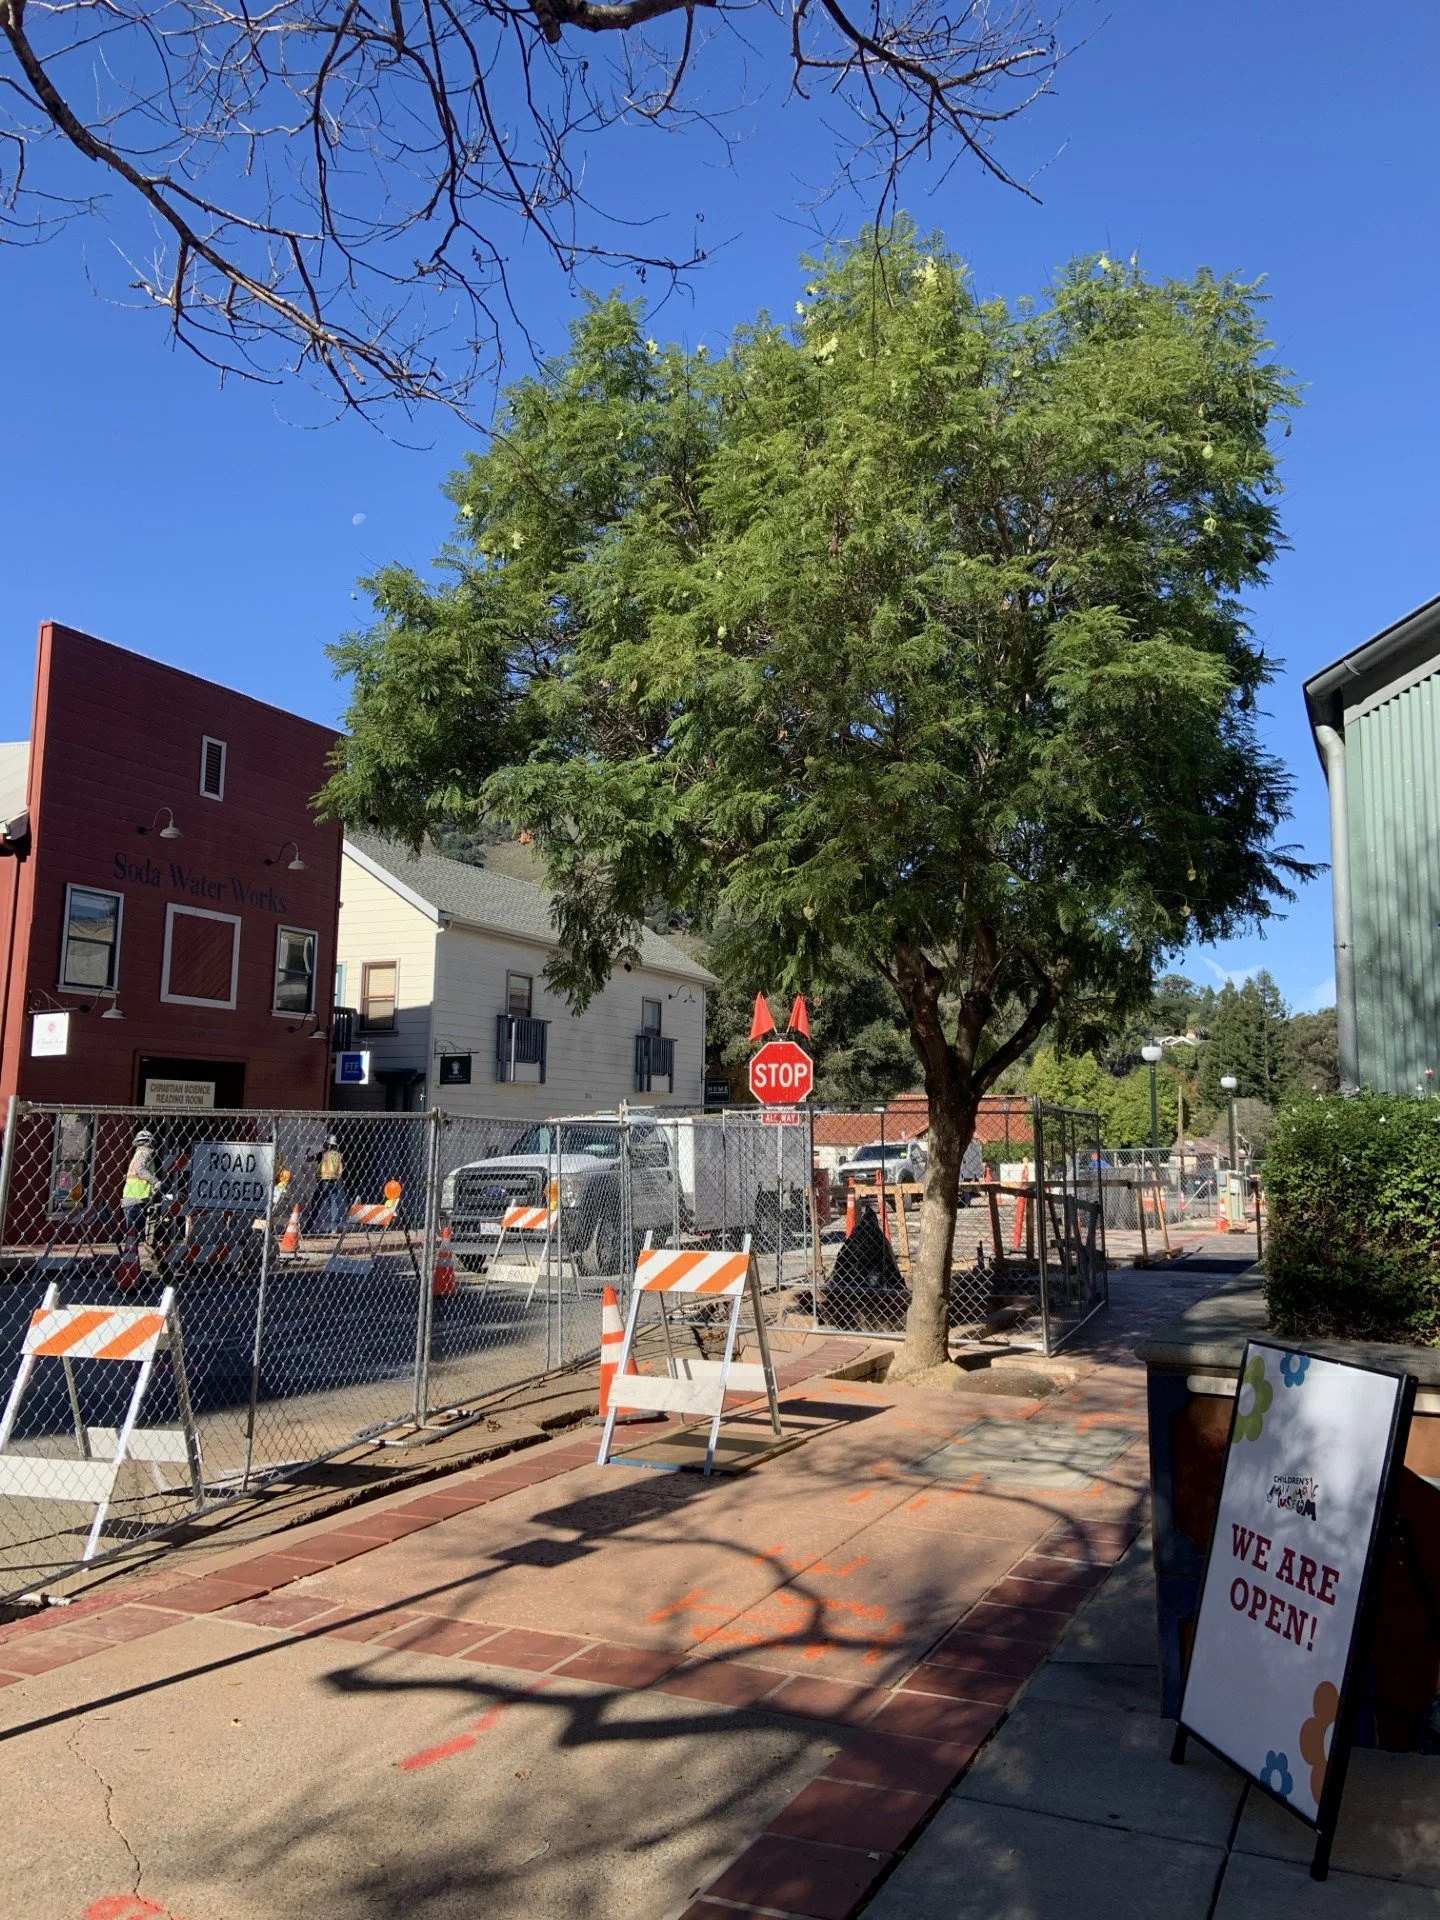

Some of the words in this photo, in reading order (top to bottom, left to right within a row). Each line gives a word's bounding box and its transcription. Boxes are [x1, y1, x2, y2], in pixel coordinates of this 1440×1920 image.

[113, 851, 161, 887] Soda
[169, 858, 227, 900] Water
[230, 876, 288, 914] Works
[754, 1063, 808, 1088] STOP
[150, 1083, 184, 1094] CHRISTIAN
[184, 1085, 211, 1095] SCIENCE
[155, 1094, 184, 1104] READING
[185, 1095, 204, 1105] ROOM
[765, 1113, 779, 1122] ALL
[781, 1113, 796, 1122] WAY
[209, 1152, 257, 1173] ROAD
[197, 1180, 264, 1202] CLOSED
[1273, 1475, 1310, 1486] CHILDREN'S
[1232, 1523, 1272, 1572] WE
[1275, 1547, 1340, 1606] ARE
[1230, 1577, 1318, 1652] OPEN!
